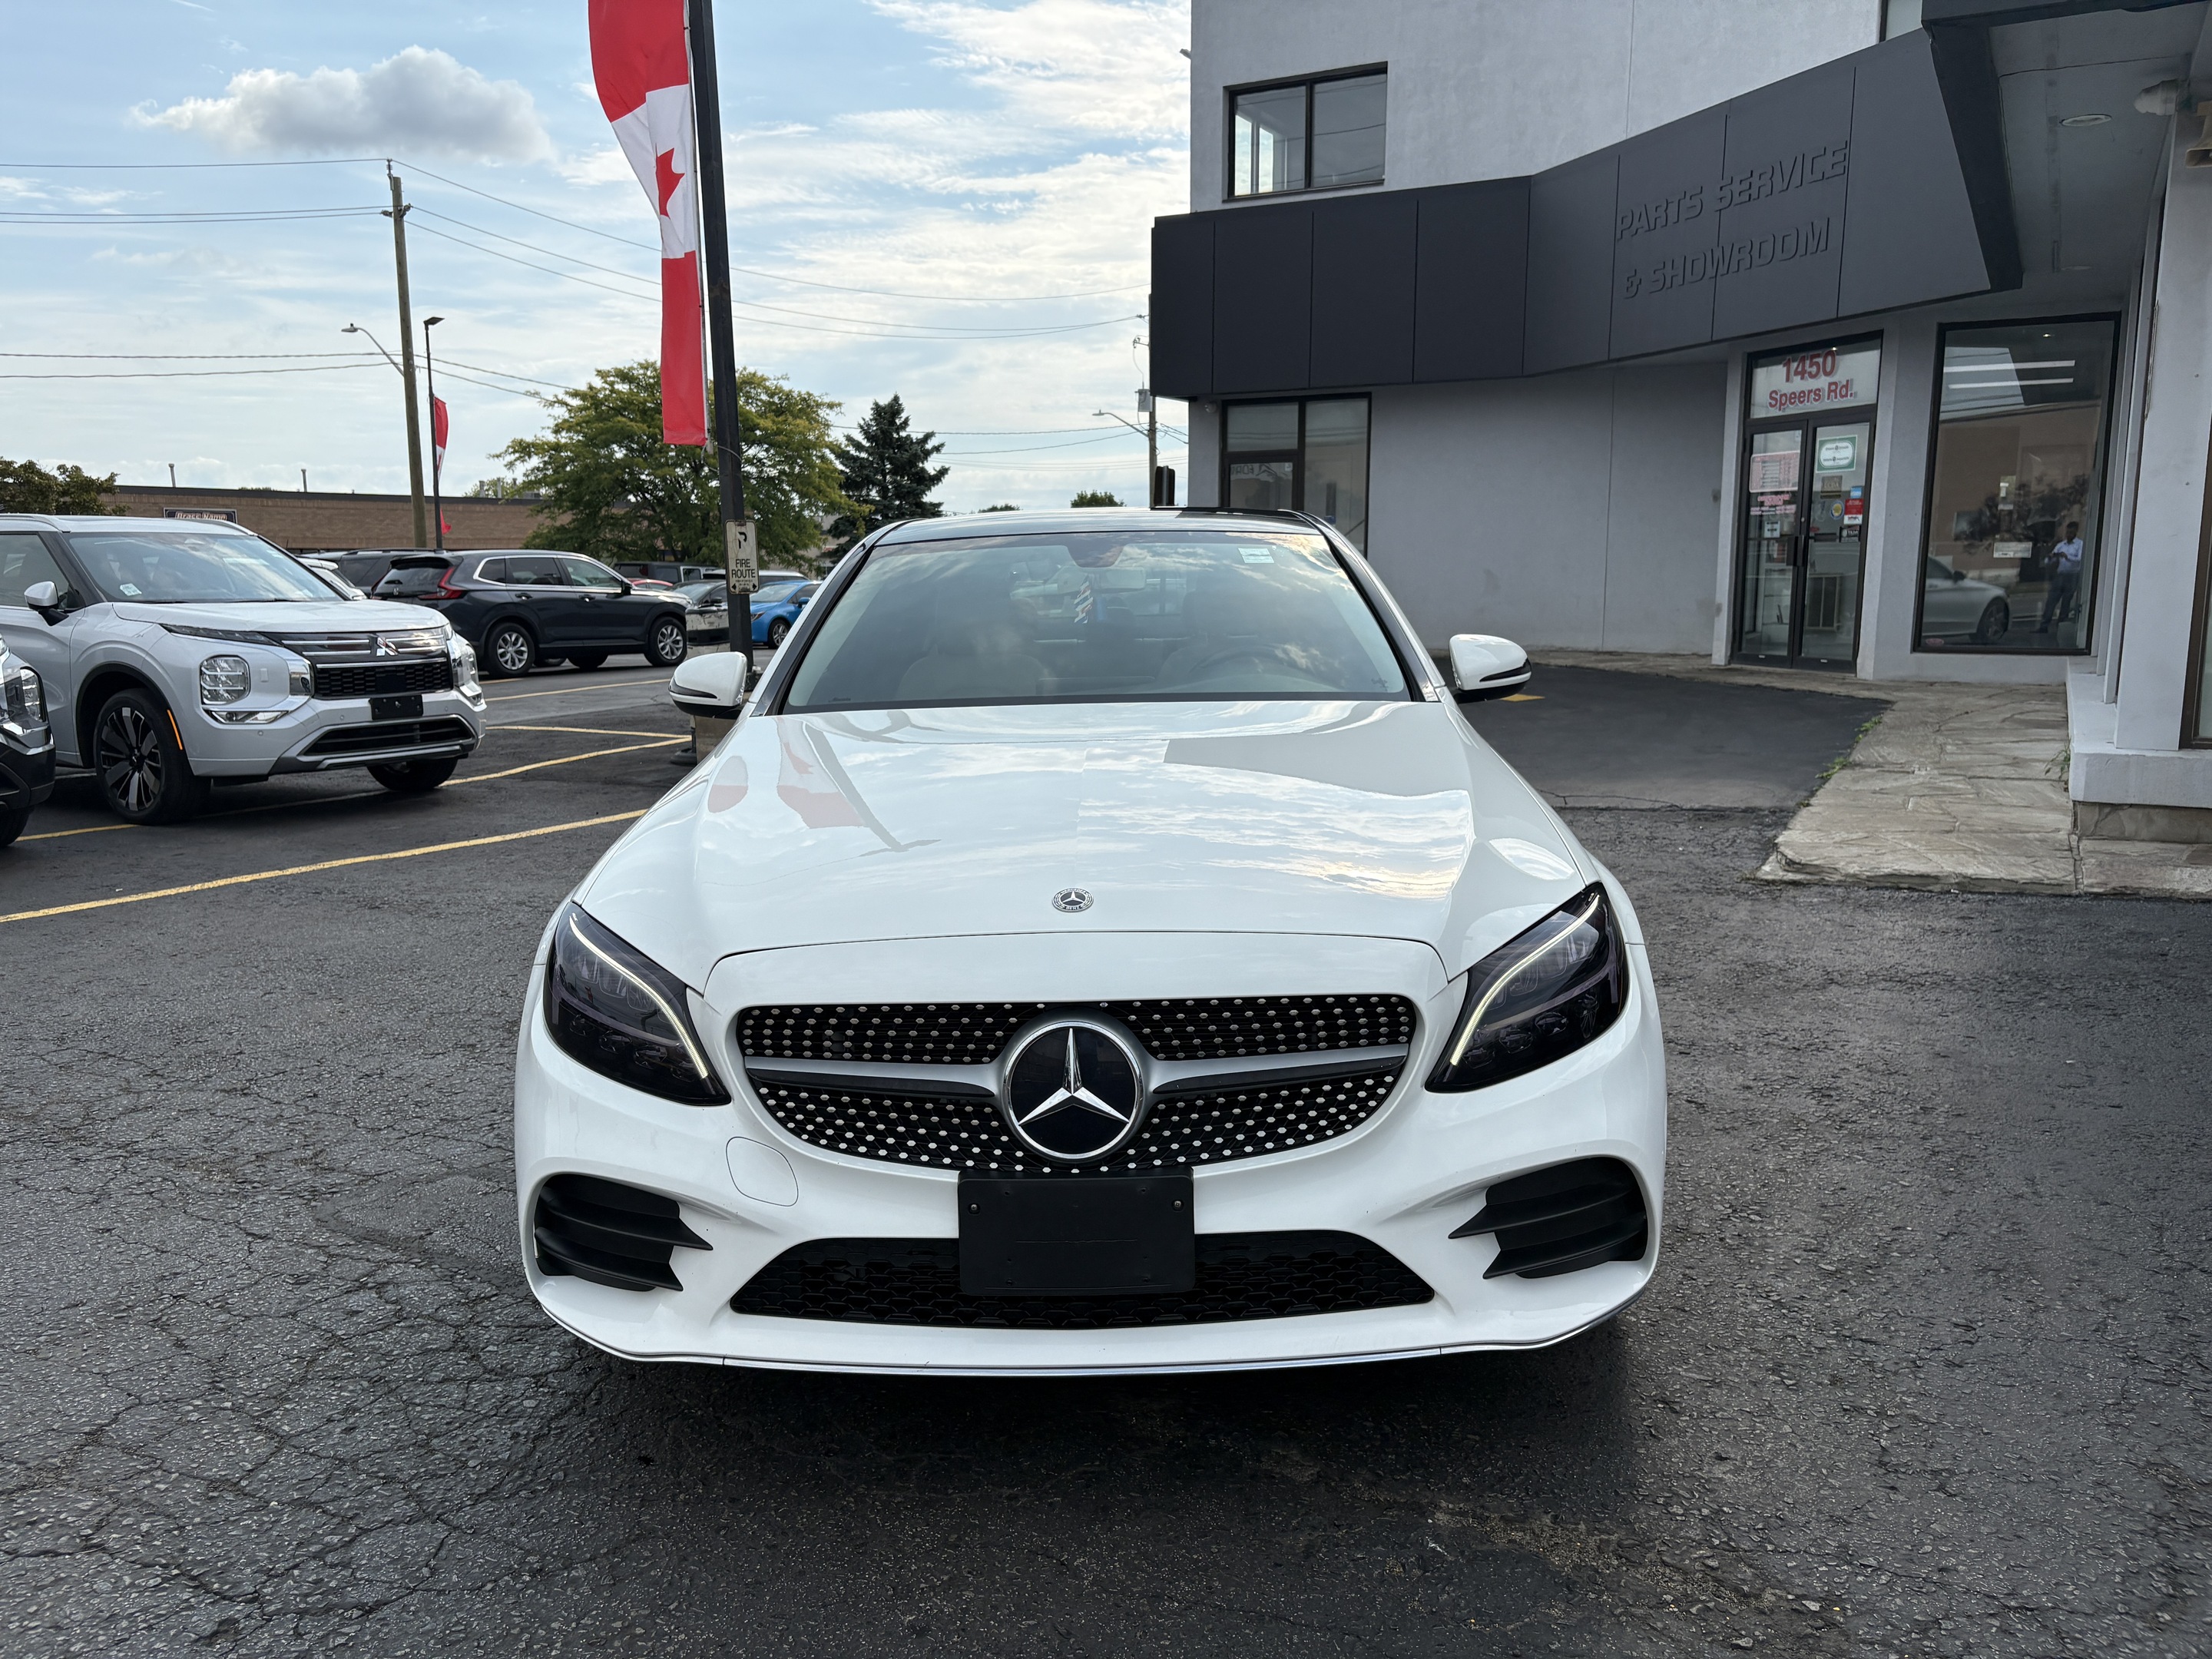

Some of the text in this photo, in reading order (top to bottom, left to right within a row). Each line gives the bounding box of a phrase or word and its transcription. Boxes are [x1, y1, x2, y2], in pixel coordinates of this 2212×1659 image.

[1618, 141, 1848, 241] PARTS SERVICE
[1623, 217, 1831, 300] & SHOWROOM
[1782, 350, 1837, 383] 1450
[1768, 379, 1854, 412] Speers Rd.
[731, 569, 756, 578] ROUTE
[735, 559, 750, 568] FIRE
